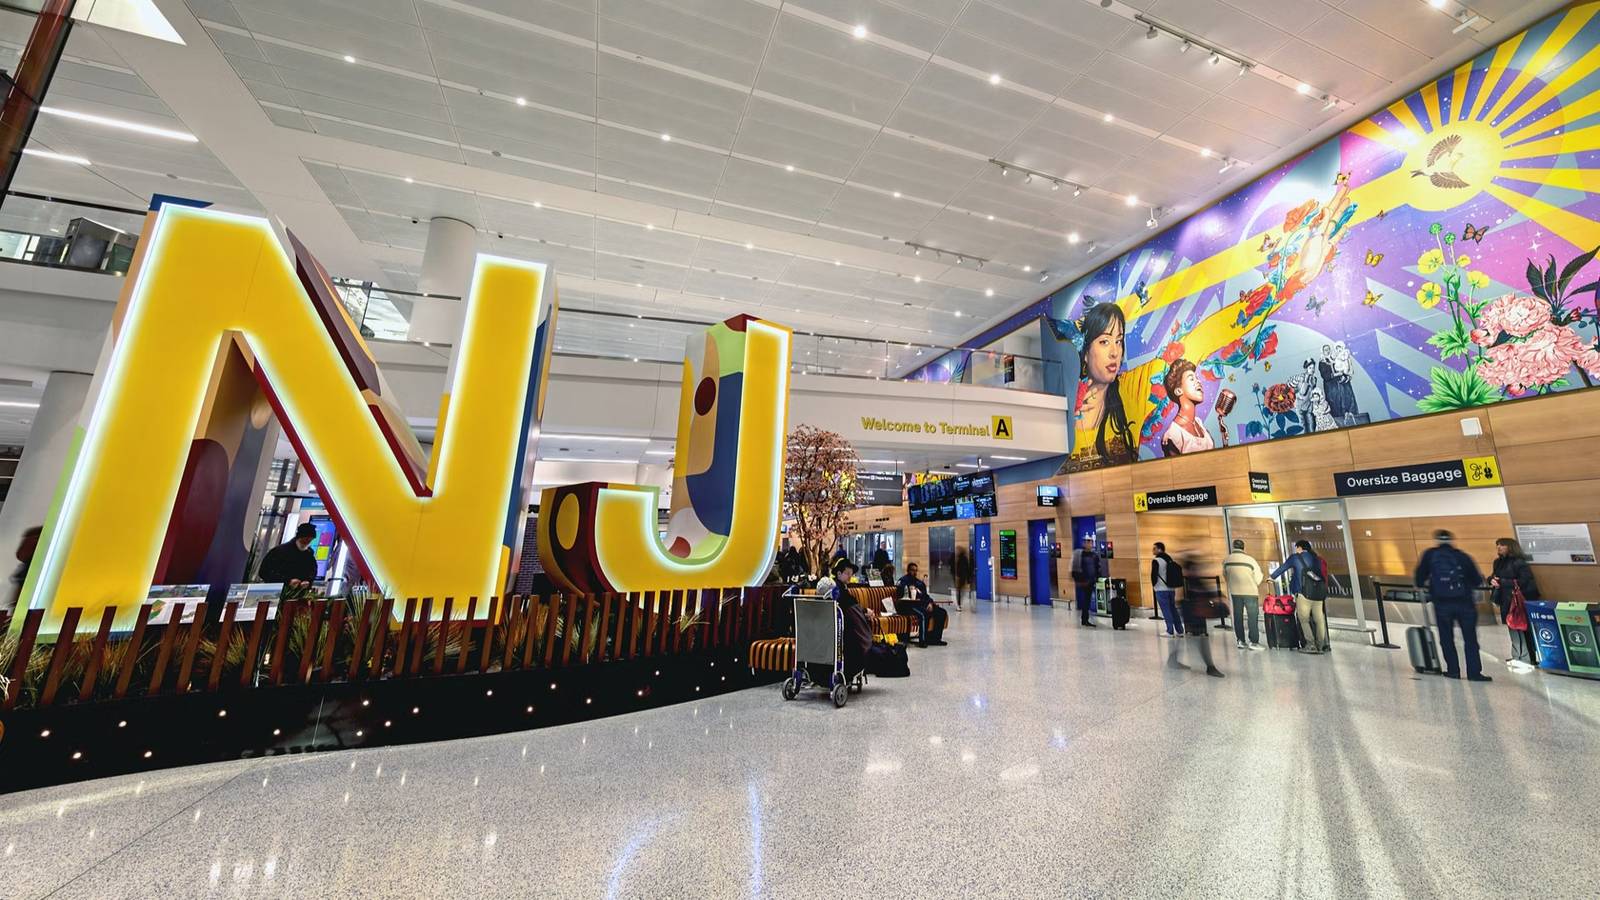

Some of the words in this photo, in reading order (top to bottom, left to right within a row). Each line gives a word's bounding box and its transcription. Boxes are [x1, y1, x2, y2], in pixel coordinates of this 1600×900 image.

[861, 416, 921, 432] Welcome
[924, 422, 937, 434] to
[939, 421, 990, 437] Terminal
[1347, 474, 1399, 488] Oversize
[1401, 468, 1462, 483] Baggage
[1147, 494, 1176, 505] Oversize
[1176, 492, 1209, 503] Baggage
